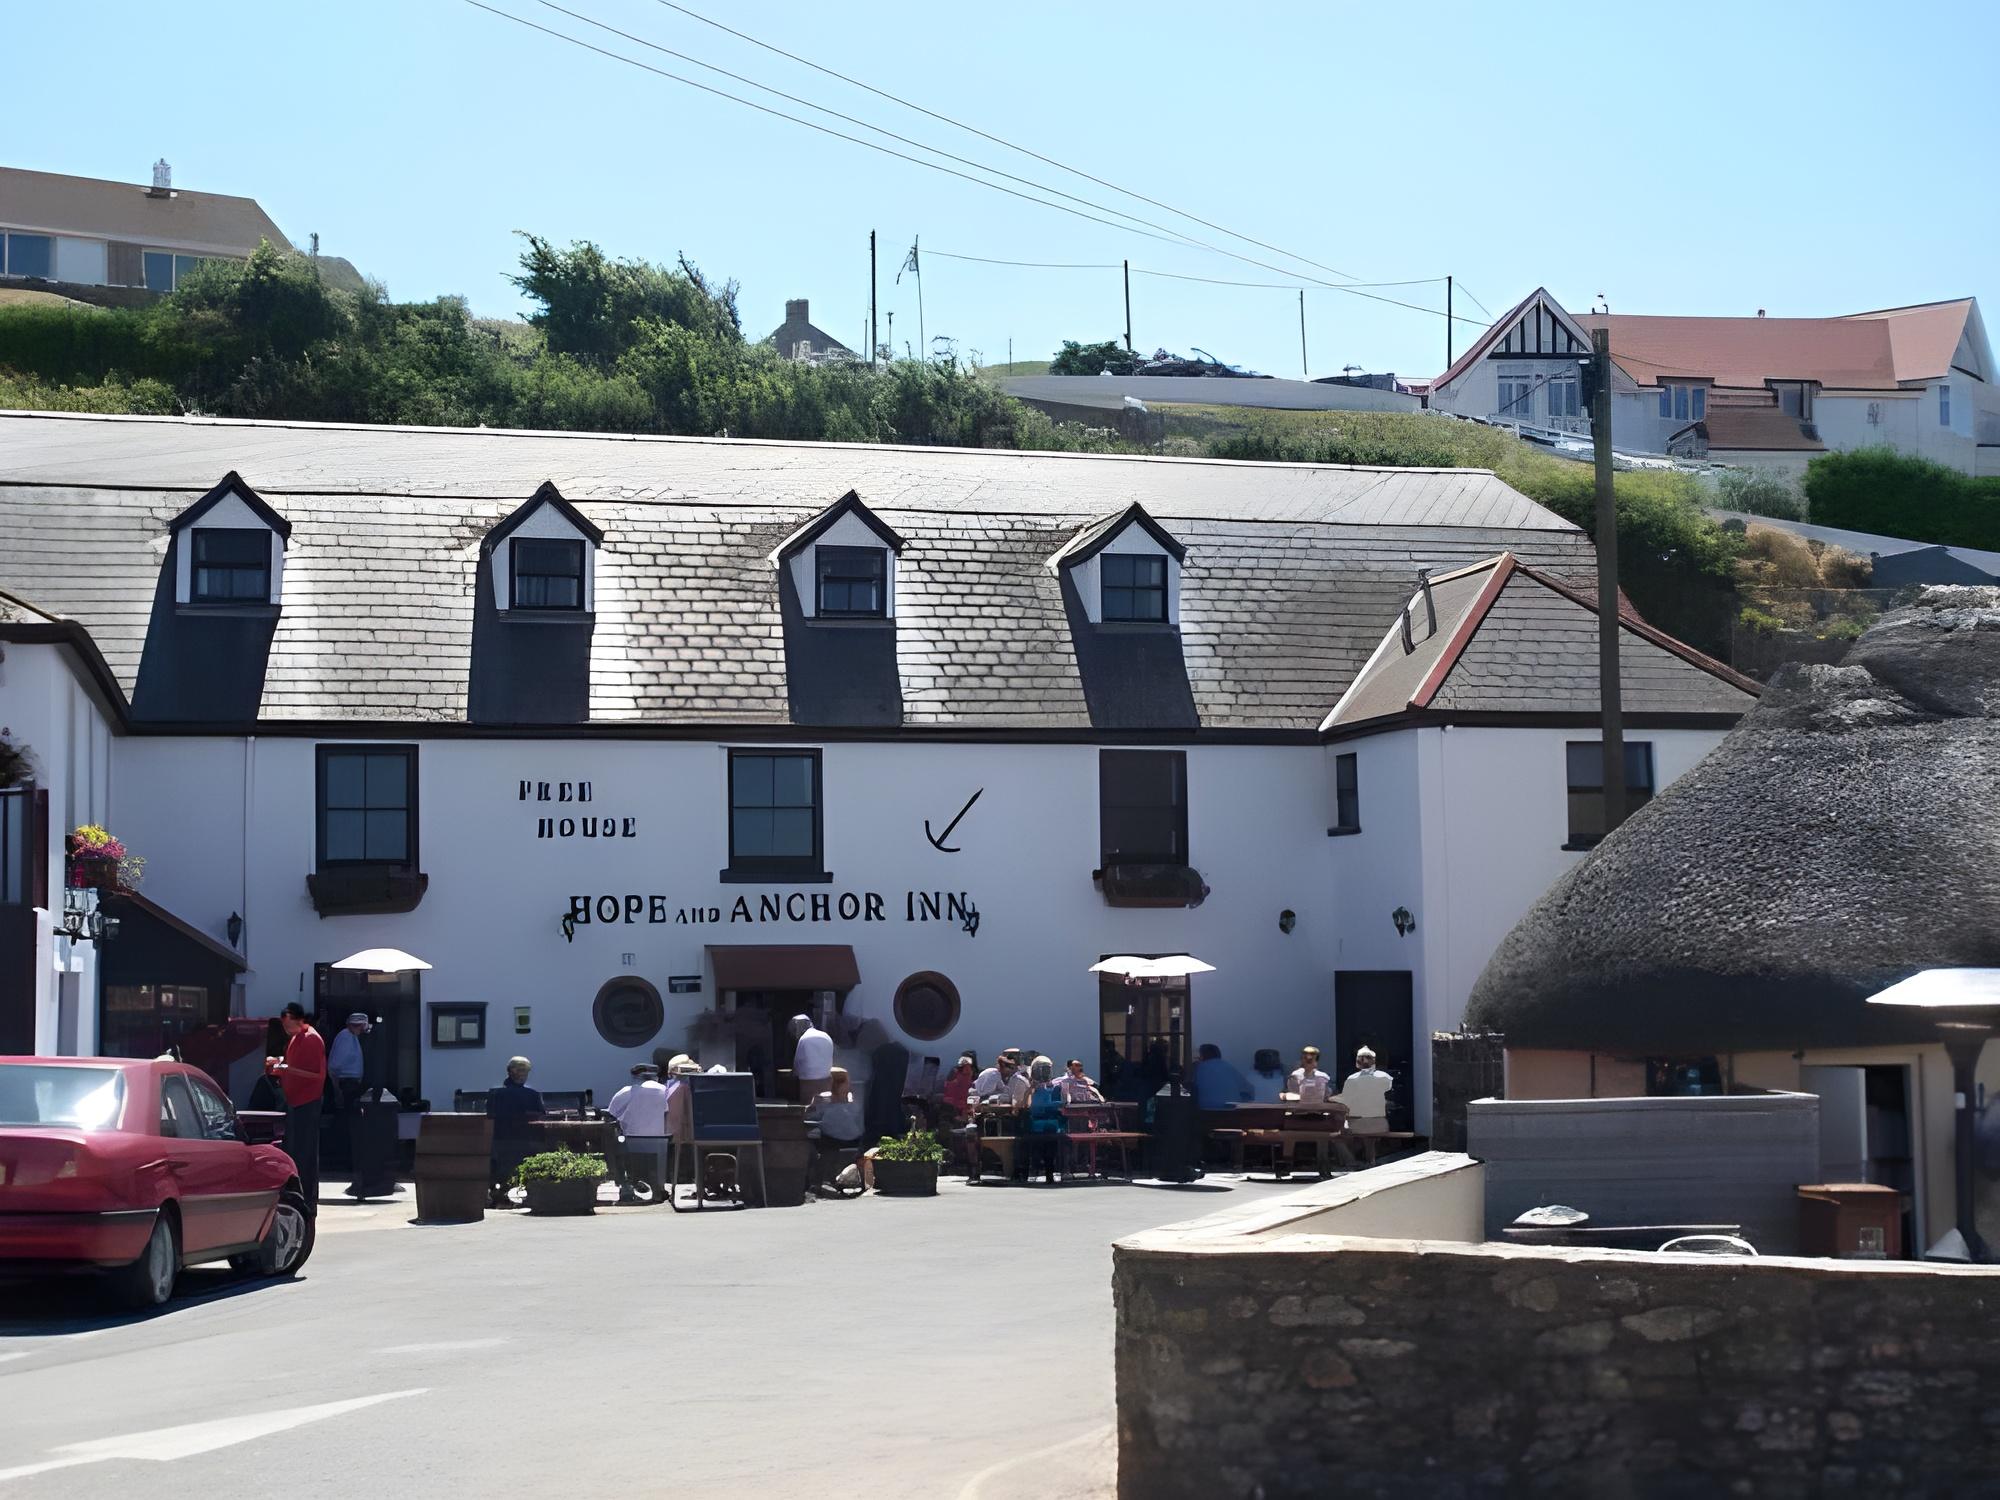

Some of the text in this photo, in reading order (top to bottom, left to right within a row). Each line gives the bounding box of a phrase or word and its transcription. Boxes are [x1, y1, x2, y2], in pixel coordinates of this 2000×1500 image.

[570, 891, 968, 924] HOPE AND ANCHOR INN
